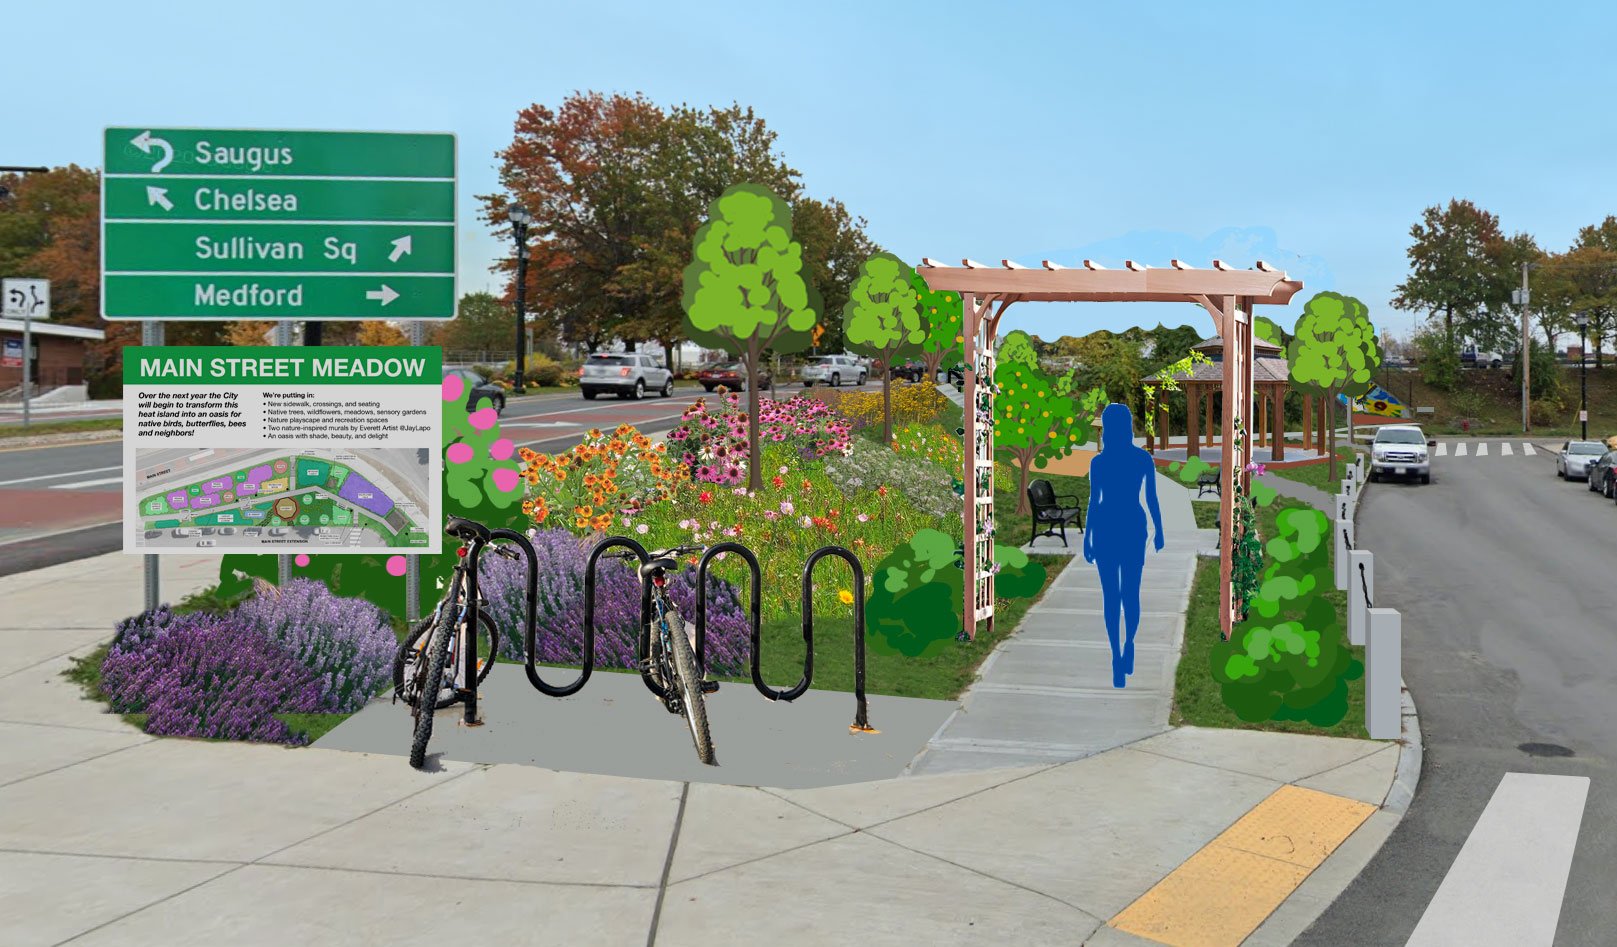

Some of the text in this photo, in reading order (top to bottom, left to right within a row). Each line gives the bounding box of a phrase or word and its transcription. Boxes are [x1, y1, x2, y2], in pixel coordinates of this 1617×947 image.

[195, 141, 293, 172] Saugus
[195, 188, 298, 212] Chelsea
[196, 236, 357, 265] Sullivan Sq
[195, 284, 303, 306] Medford
[140, 358, 426, 377] MAIN STREET MEADOW
[223, 392, 238, 400] City
[154, 429, 194, 437] neighbors!
[163, 420, 184, 428] birds,
[186, 420, 226, 428] butterflies,
